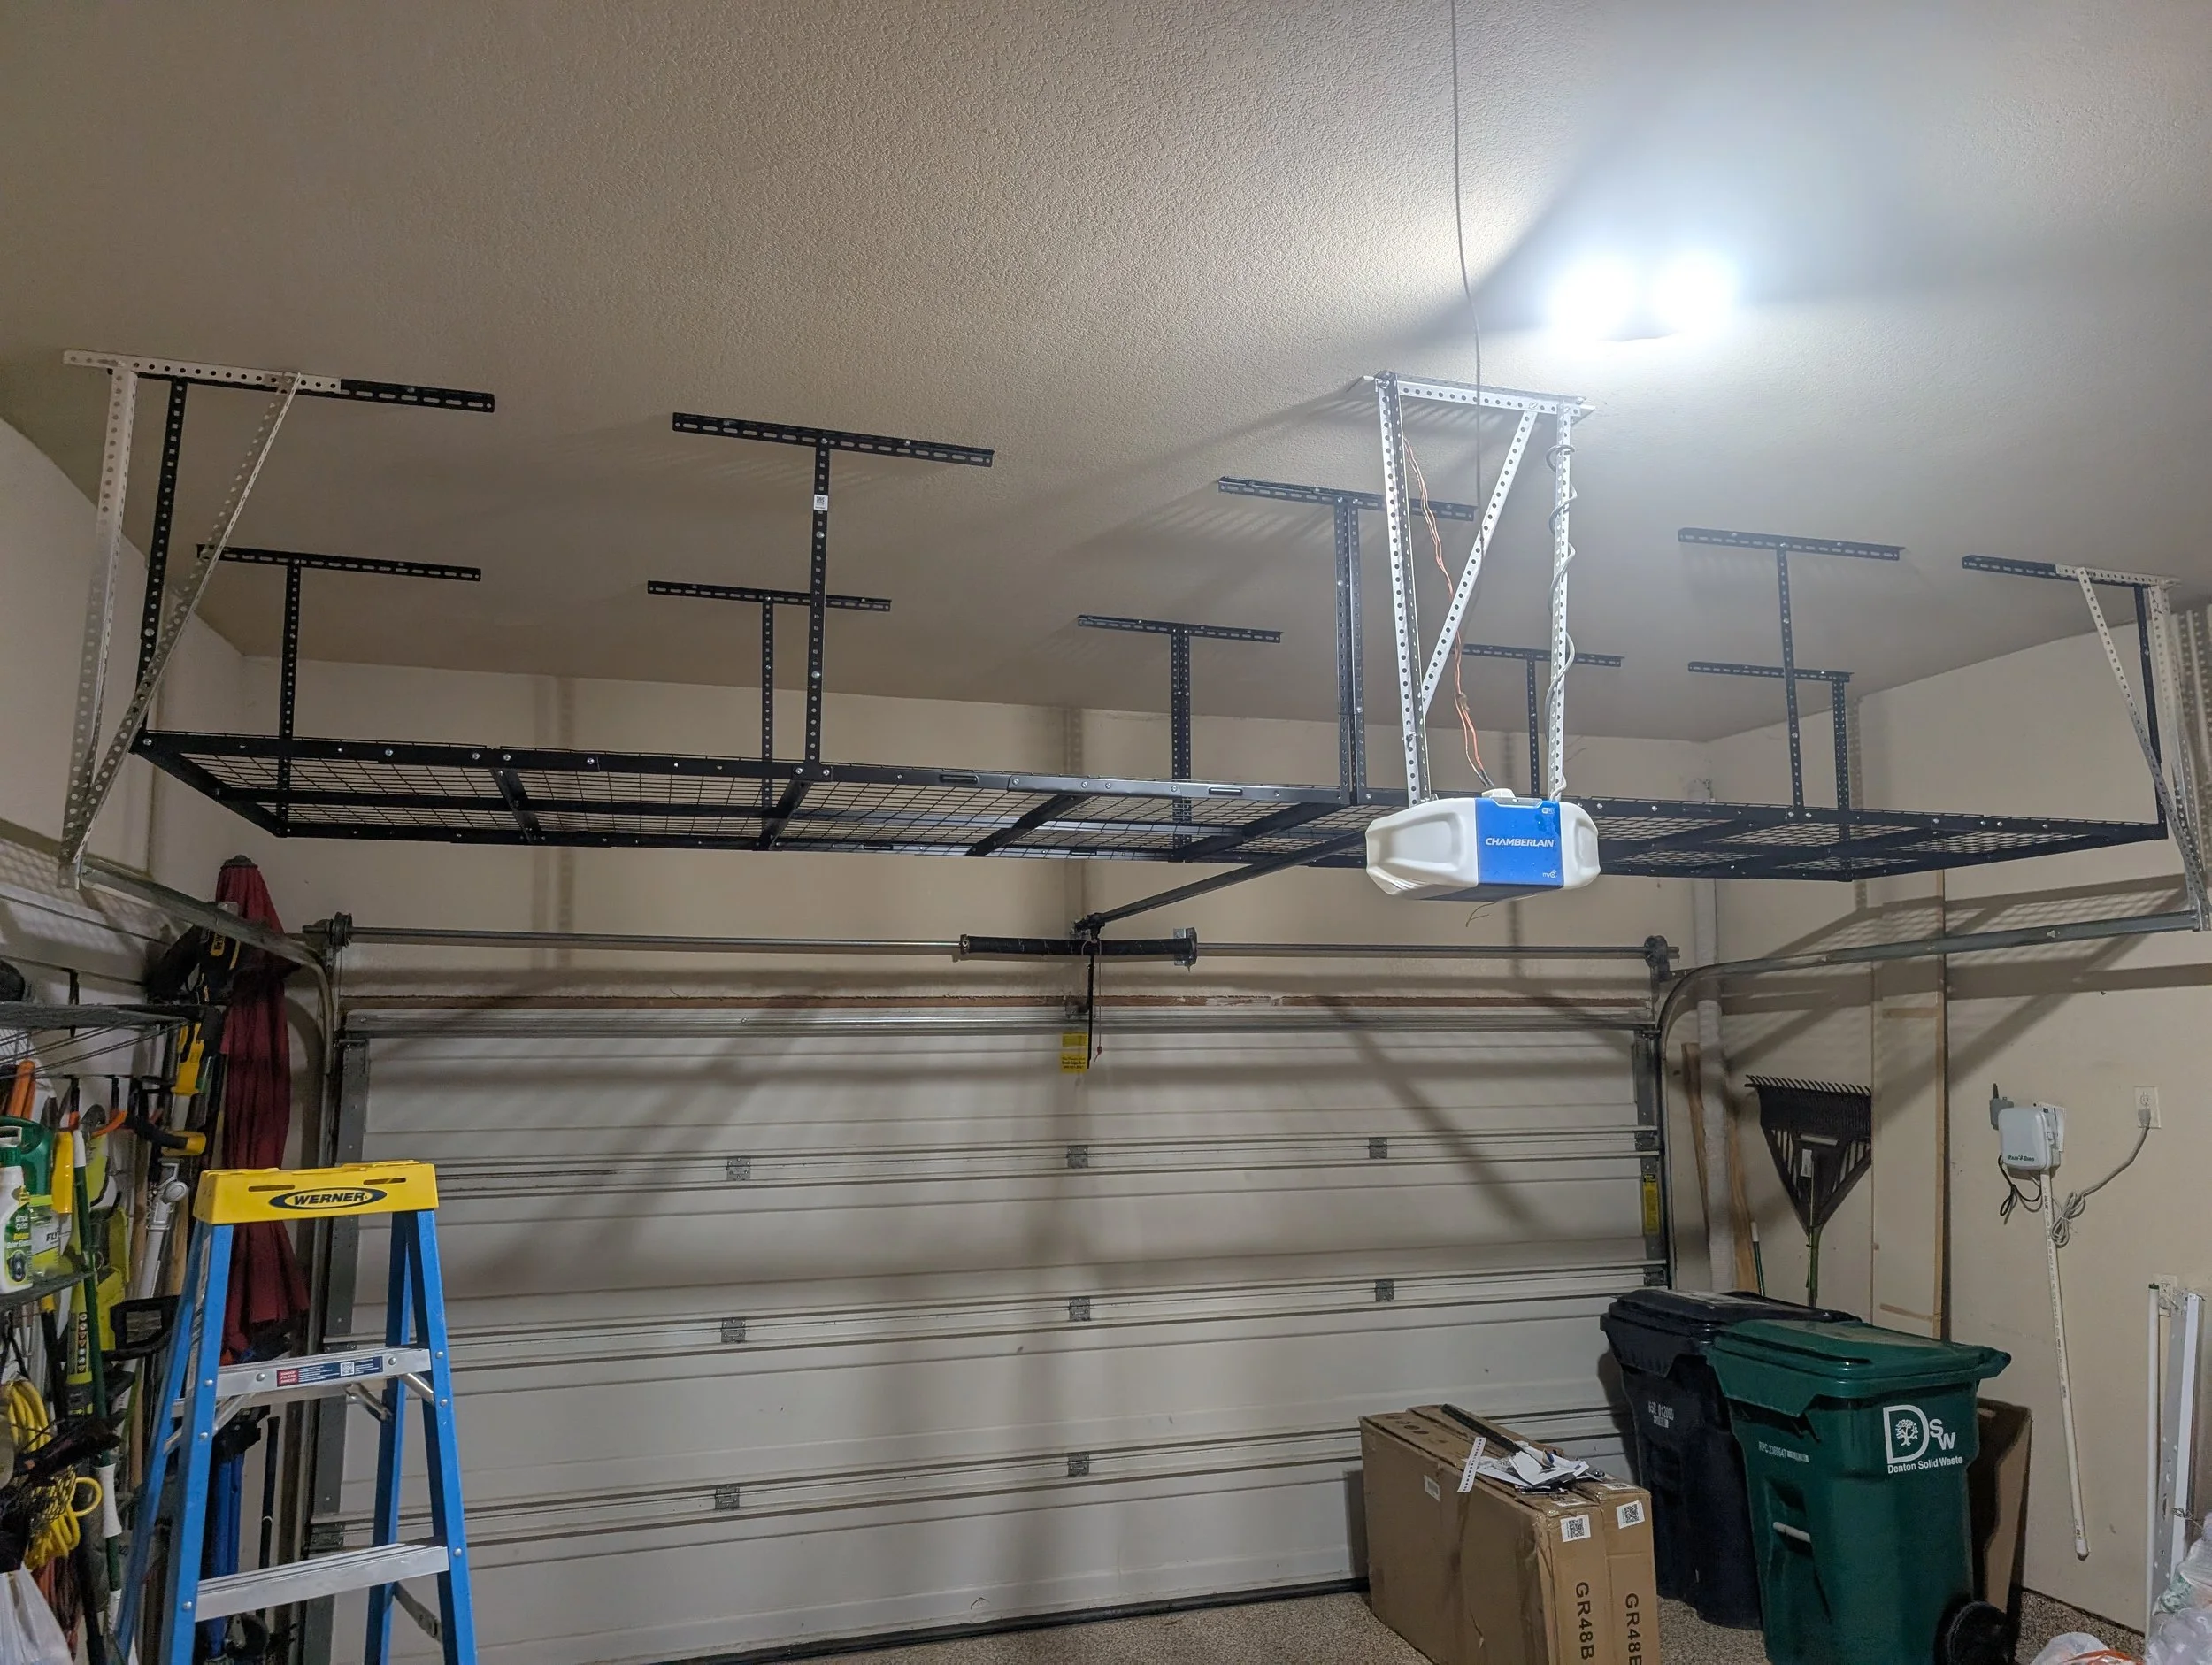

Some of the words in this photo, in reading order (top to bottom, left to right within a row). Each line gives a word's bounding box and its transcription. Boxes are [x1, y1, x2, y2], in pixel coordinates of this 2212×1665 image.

[1485, 837, 1555, 848] CHAMBERLAIN
[293, 1191, 365, 1206] WERNER
[1887, 1463, 1917, 1475] Denton
[1917, 1458, 1939, 1469] Solid
[1939, 1455, 1963, 1467] Waste
[1575, 1581, 1594, 1661] GR48B
